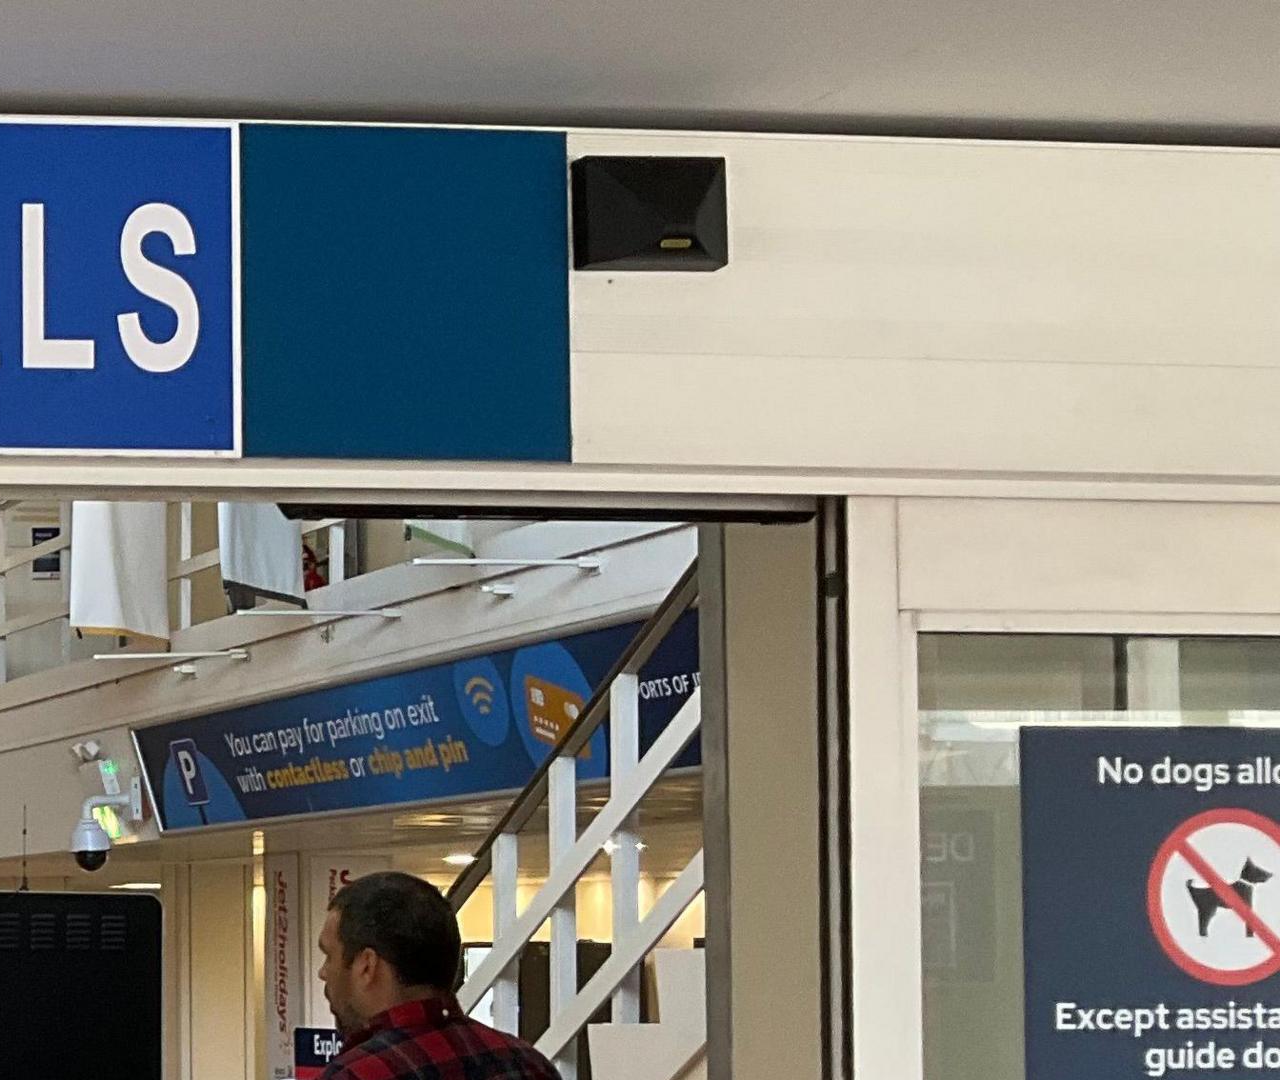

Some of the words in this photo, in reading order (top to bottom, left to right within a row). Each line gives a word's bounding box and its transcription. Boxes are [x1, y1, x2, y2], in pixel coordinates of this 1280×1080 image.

[639, 676, 672, 699] ORTS
[672, 673, 689, 693] OF
[224, 732, 250, 758] You
[252, 731, 276, 754] can
[278, 725, 303, 755] pay
[303, 717, 324, 744] for
[327, 706, 385, 747] parking
[384, 707, 406, 731] on
[407, 695, 440, 727] exit
[237, 766, 267, 794] with
[266, 756, 350, 789] contactless
[349, 753, 367, 778] or
[367, 745, 405, 780] chip
[405, 737, 438, 770] and
[438, 734, 469, 772] pin
[1097, 756, 1143, 784] No
[1150, 756, 1230, 792] dogs
[276, 870, 288, 1033] Jet2holidays
[1055, 1003, 1170, 1037] Except
[1144, 1041, 1236, 1077] guide
